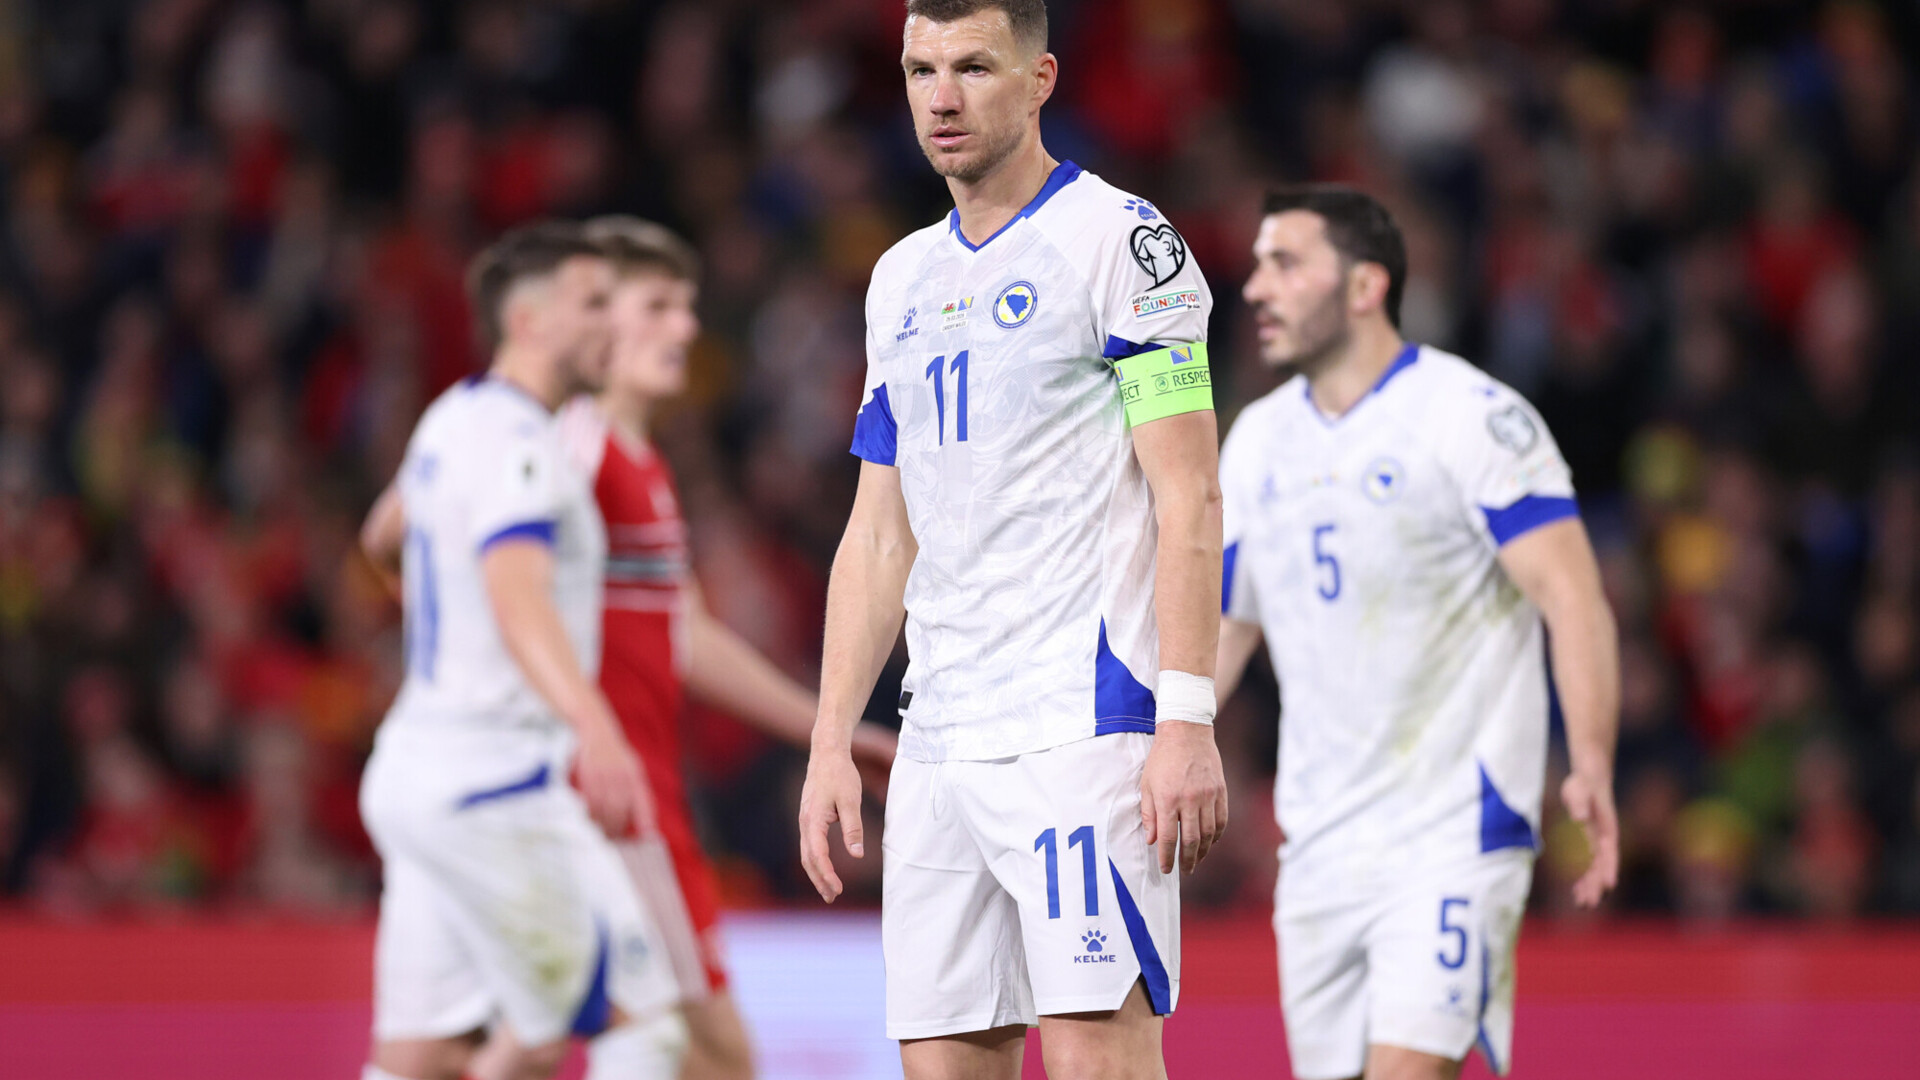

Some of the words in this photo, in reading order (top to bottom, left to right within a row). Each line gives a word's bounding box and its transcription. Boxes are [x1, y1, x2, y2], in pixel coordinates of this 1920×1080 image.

[1132, 295, 1150, 305] UEFA
[1133, 293, 1200, 314] FOUNDATION
[896, 327, 919, 343] KELME
[926, 350, 969, 446] 11
[1313, 523, 1342, 601] 5
[1034, 825, 1100, 919] 11
[1436, 898, 1469, 970] 5
[1074, 955, 1116, 963] KELME
